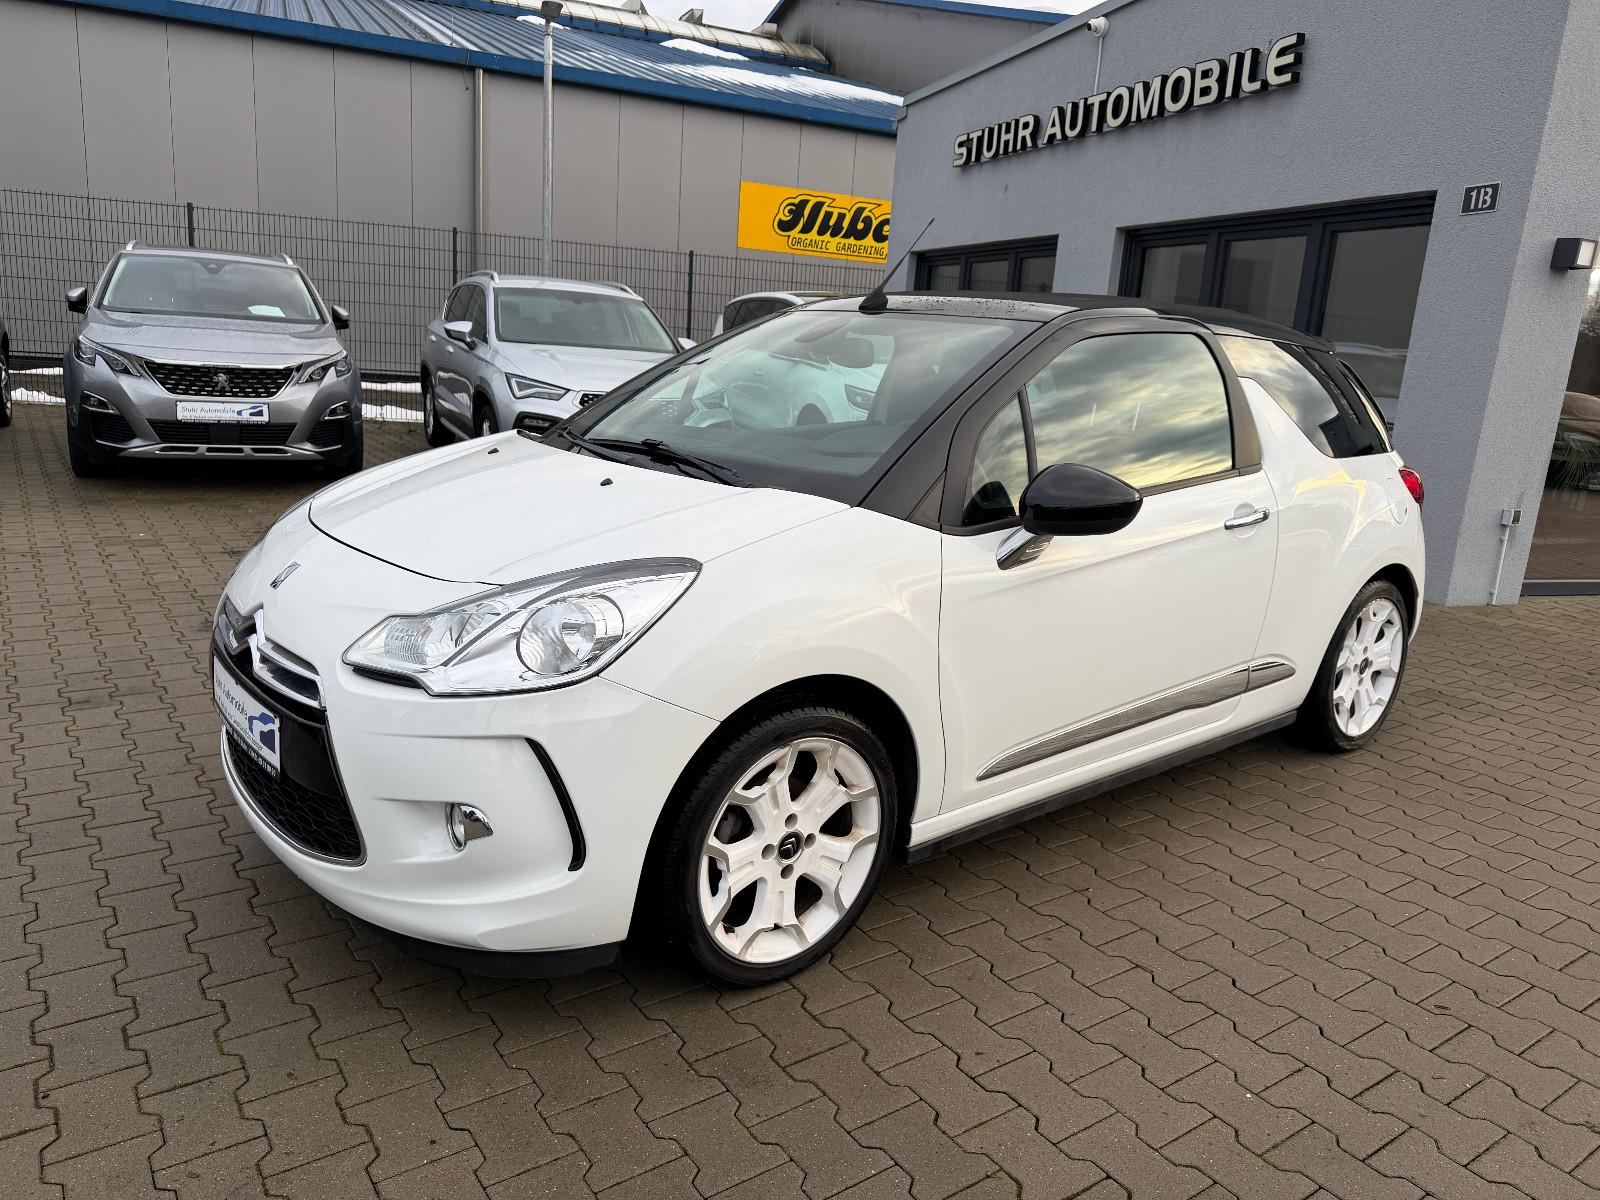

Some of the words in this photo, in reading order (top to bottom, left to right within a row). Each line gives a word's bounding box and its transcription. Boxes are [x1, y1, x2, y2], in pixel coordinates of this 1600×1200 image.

[952, 114, 1038, 168] STUHR
[1042, 32, 1305, 145] AUTOMOBILE
[1470, 187, 1493, 210] 1B
[790, 236, 831, 251] ORGANIC
[199, 406, 236, 415] Automobile
